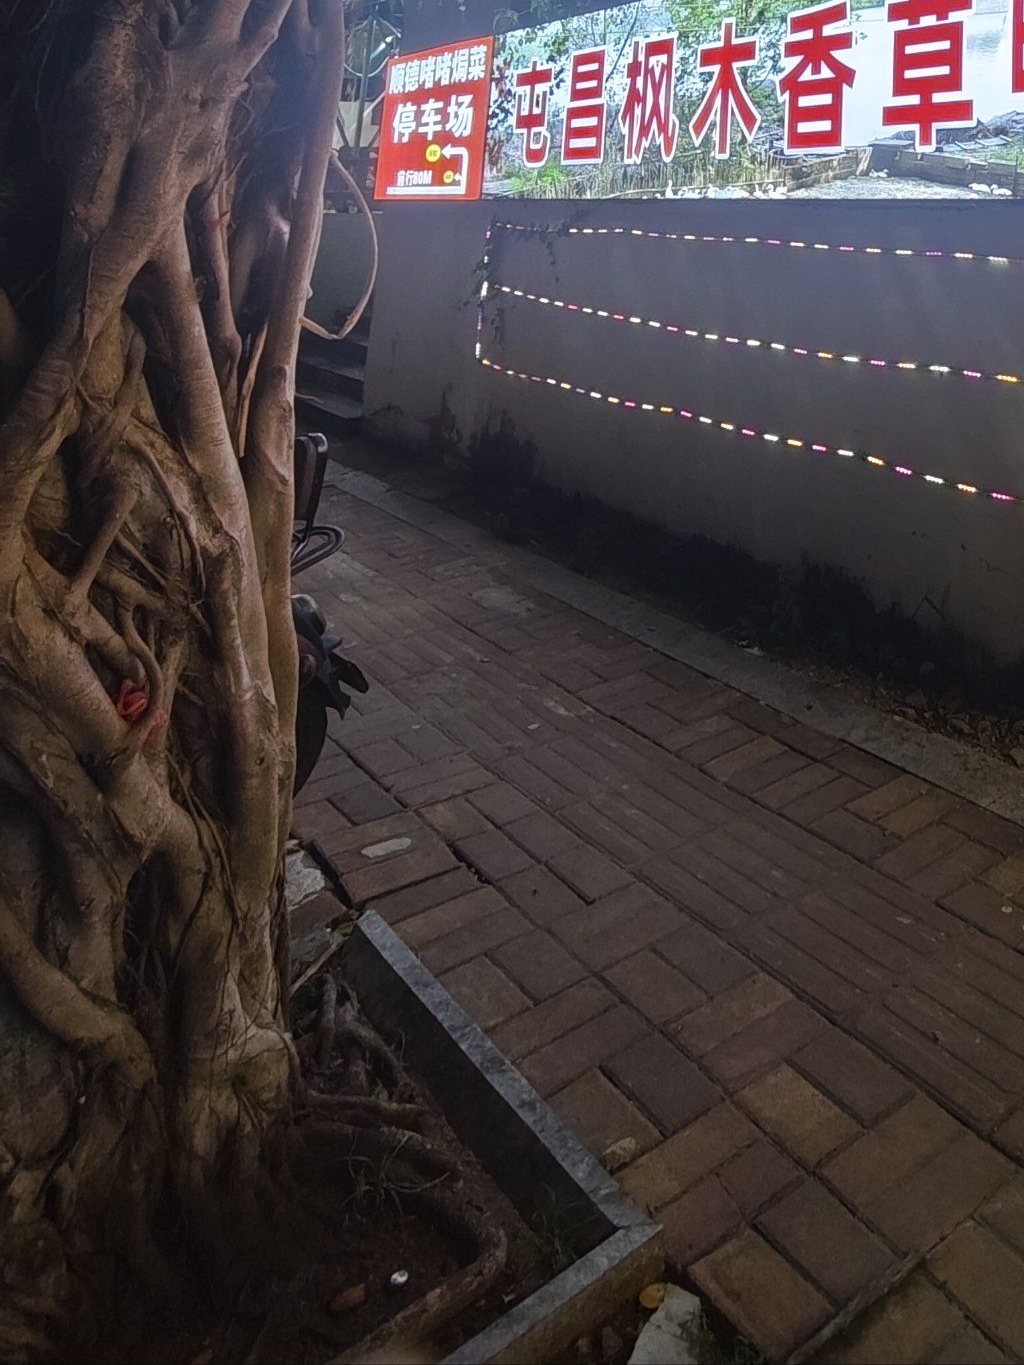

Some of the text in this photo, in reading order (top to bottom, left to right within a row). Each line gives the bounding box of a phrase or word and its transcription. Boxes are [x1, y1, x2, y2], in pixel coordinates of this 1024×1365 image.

[389, 44, 488, 95] 顺德啫啫焗菜
[392, 94, 474, 144] 停车场
